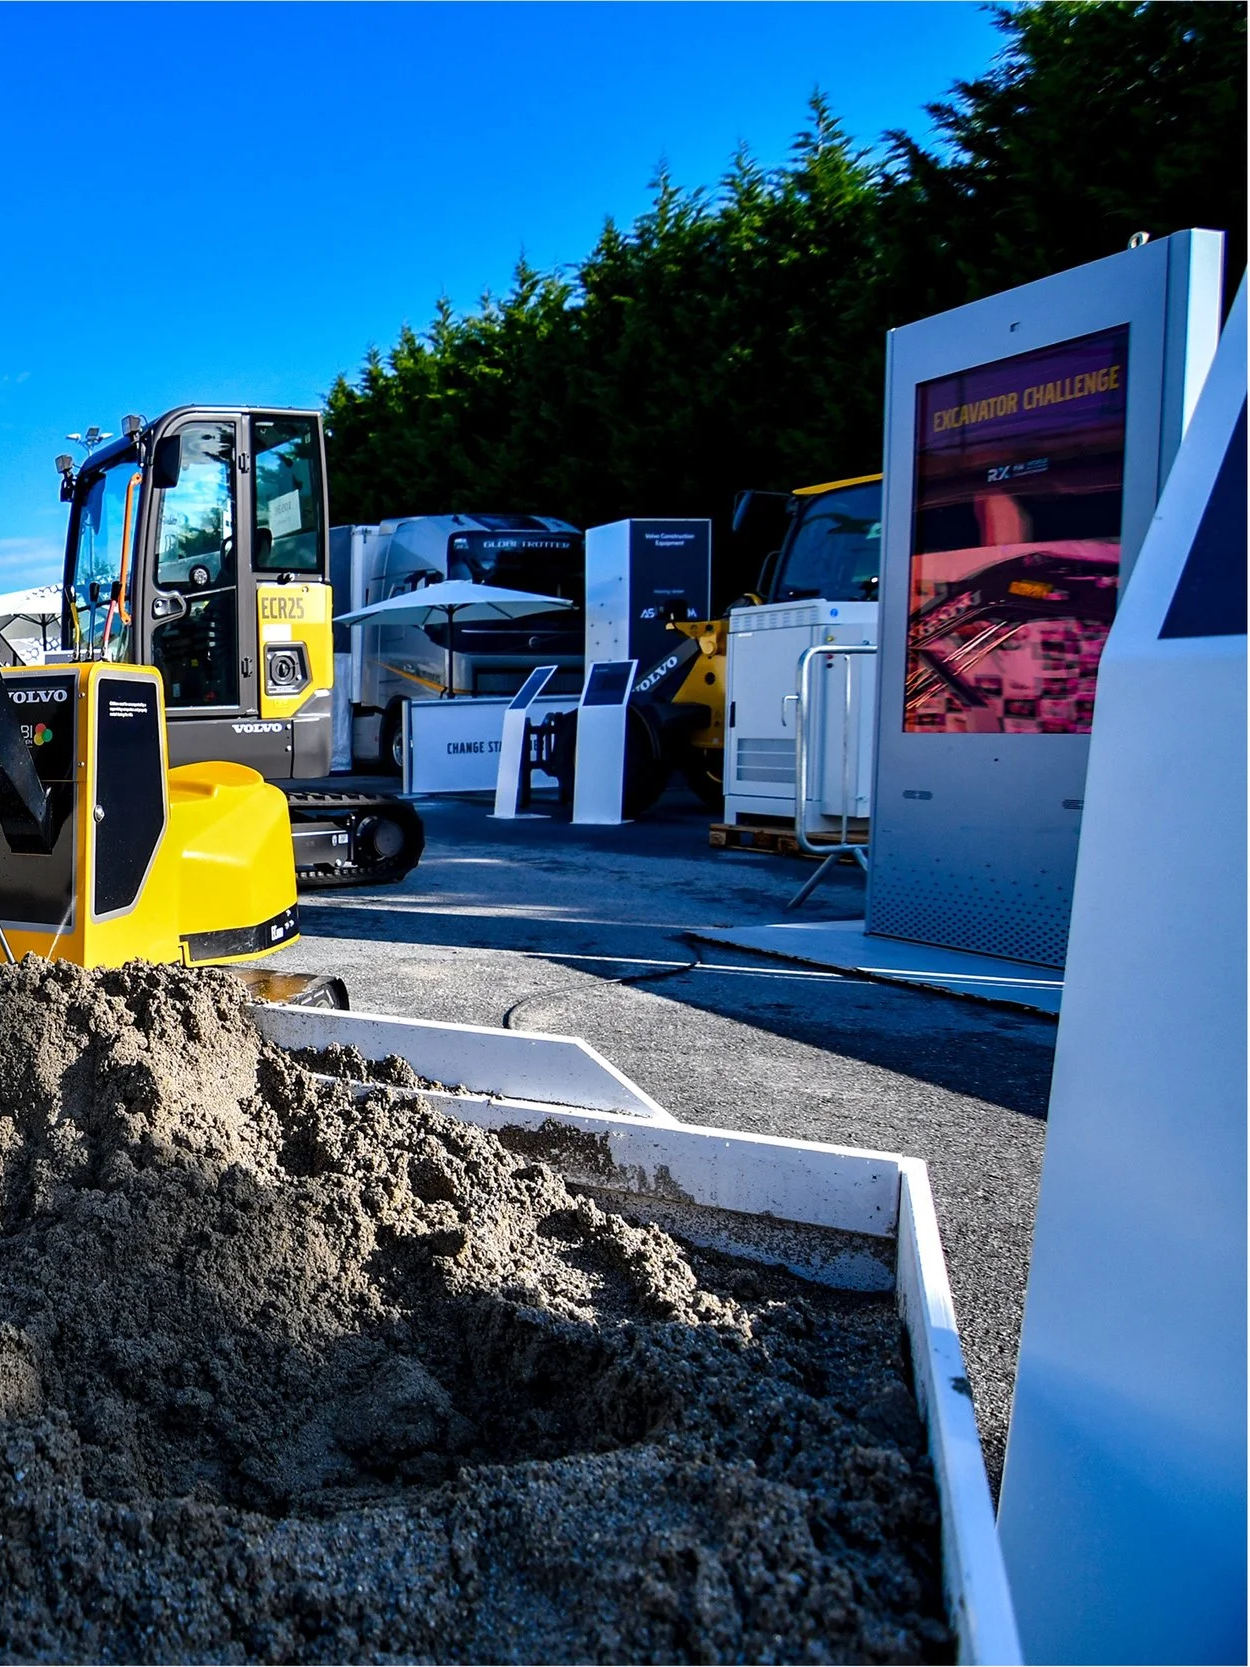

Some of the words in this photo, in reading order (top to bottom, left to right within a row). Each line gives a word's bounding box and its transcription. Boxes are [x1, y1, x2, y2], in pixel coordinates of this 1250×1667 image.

[933, 392, 1018, 433] EXCAVATOR
[1023, 365, 1120, 411] CHALLENGE
[261, 597, 305, 619] ECR25
[231, 722, 283, 734] VOLVO
[447, 741, 485, 754] CHANGE
